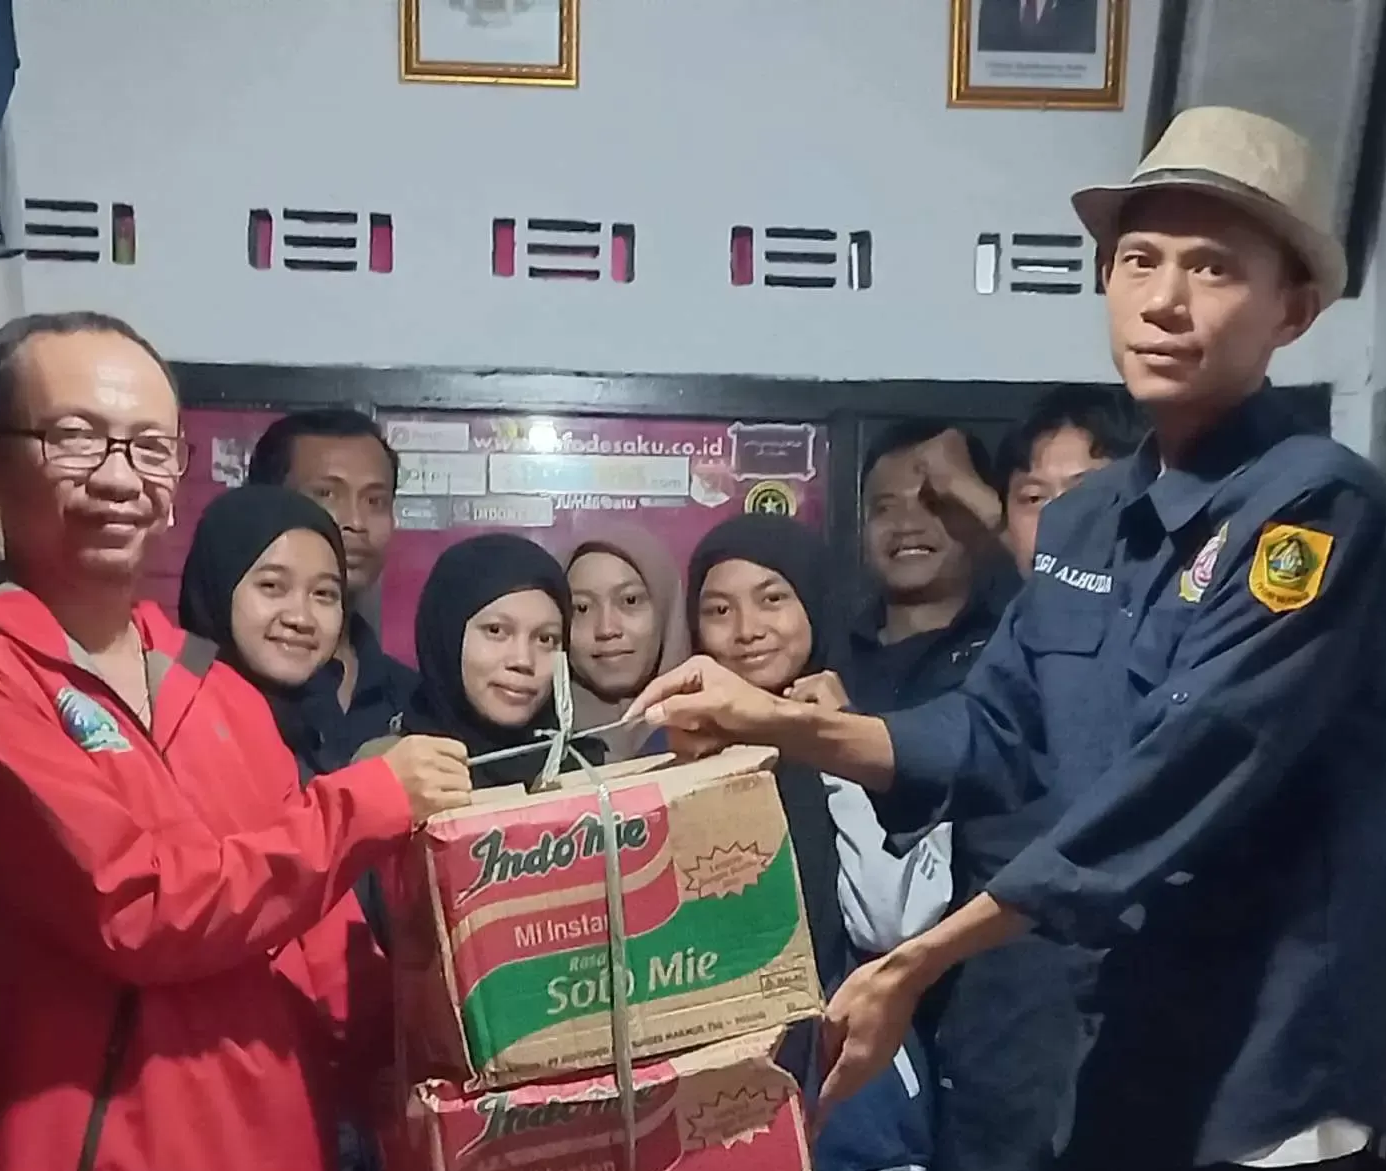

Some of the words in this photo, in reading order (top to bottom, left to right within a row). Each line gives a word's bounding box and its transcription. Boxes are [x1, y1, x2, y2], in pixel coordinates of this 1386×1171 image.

[474, 431, 722, 455] wwwfodesaku.co.id
[547, 914, 608, 941] Insta
[648, 947, 718, 992] Mie
